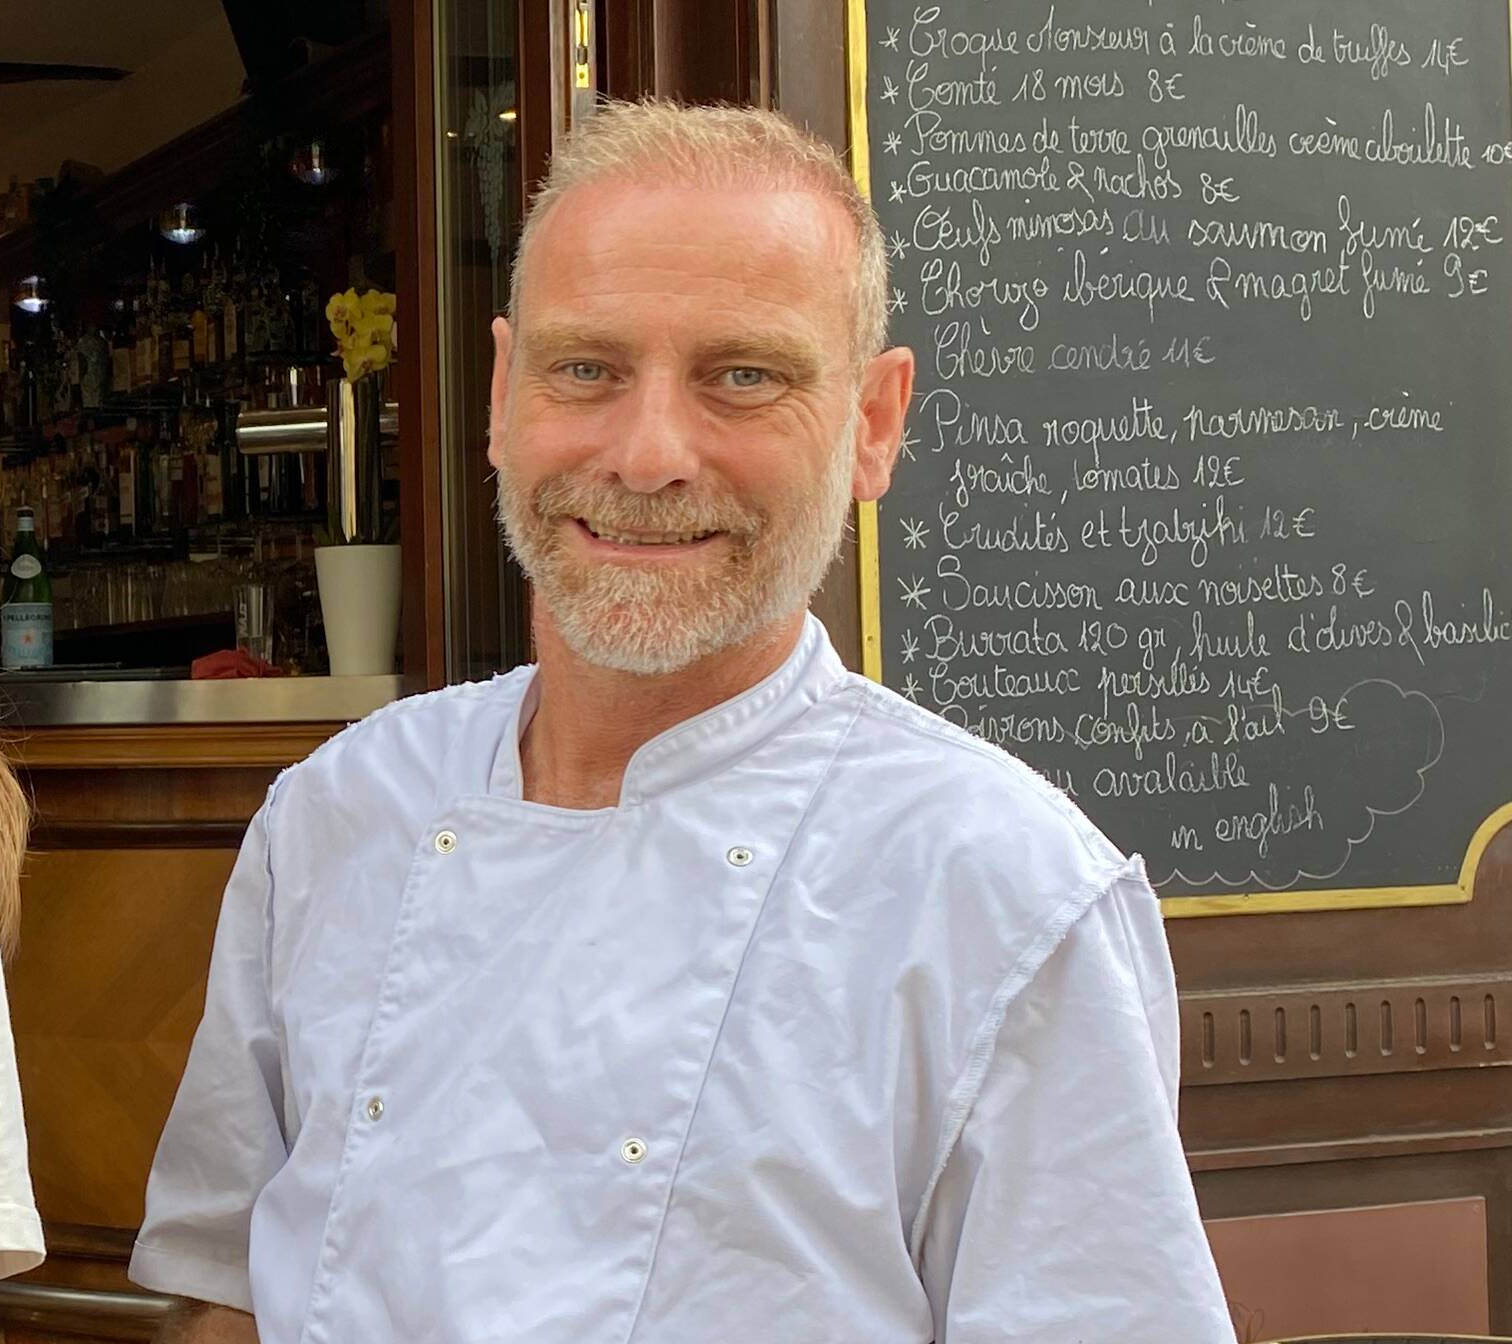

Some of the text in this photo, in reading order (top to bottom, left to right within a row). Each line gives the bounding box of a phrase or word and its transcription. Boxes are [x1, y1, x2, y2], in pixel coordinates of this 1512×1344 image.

[909, 6, 1019, 71] Croque
[1298, 24, 1326, 63] de
[1333, 23, 1411, 80] truffes
[1422, 37, 1469, 74] 14€
[905, 59, 1185, 111] Comté 18 mois 8€
[904, 110, 1026, 155] Pommes
[1033, 117, 1064, 154] de
[1068, 115, 1131, 154] terre
[1142, 104, 1276, 169] grenailles
[1290, 117, 1362, 160] crème
[907, 156, 1060, 197] Guacamole
[1094, 154, 1182, 200] nachos
[1200, 172, 1240, 204] 8€
[1006, 198, 1113, 239] mimosas
[1123, 209, 1170, 244] au
[1188, 219, 1326, 253] saumon
[1338, 195, 1433, 255] fumé
[1443, 216, 1504, 250] 12€
[920, 258, 1048, 331] Chorizo
[1235, 248, 1350, 321] magret
[1361, 249, 1430, 318] fumé
[1444, 253, 1488, 297] 9€
[934, 314, 1036, 380] Chèvre
[920, 389, 1028, 452] Pinsa
[1073, 457, 1180, 491] tomates
[1193, 456, 1245, 488] 12€
[939, 502, 1069, 552] Crudités
[1081, 509, 1112, 548] et
[1260, 506, 1316, 539] 12€
[937, 555, 1376, 610] Saucisson aux noisettes 8€
[924, 615, 1068, 662] Burrata
[1078, 621, 1129, 656] 120
[1189, 610, 1271, 663] huile
[1423, 587, 1512, 649] basilic
[929, 661, 1272, 720] Couteaux persillés 14€
[1309, 695, 1355, 734] 9€
[1216, 782, 1325, 857] english
